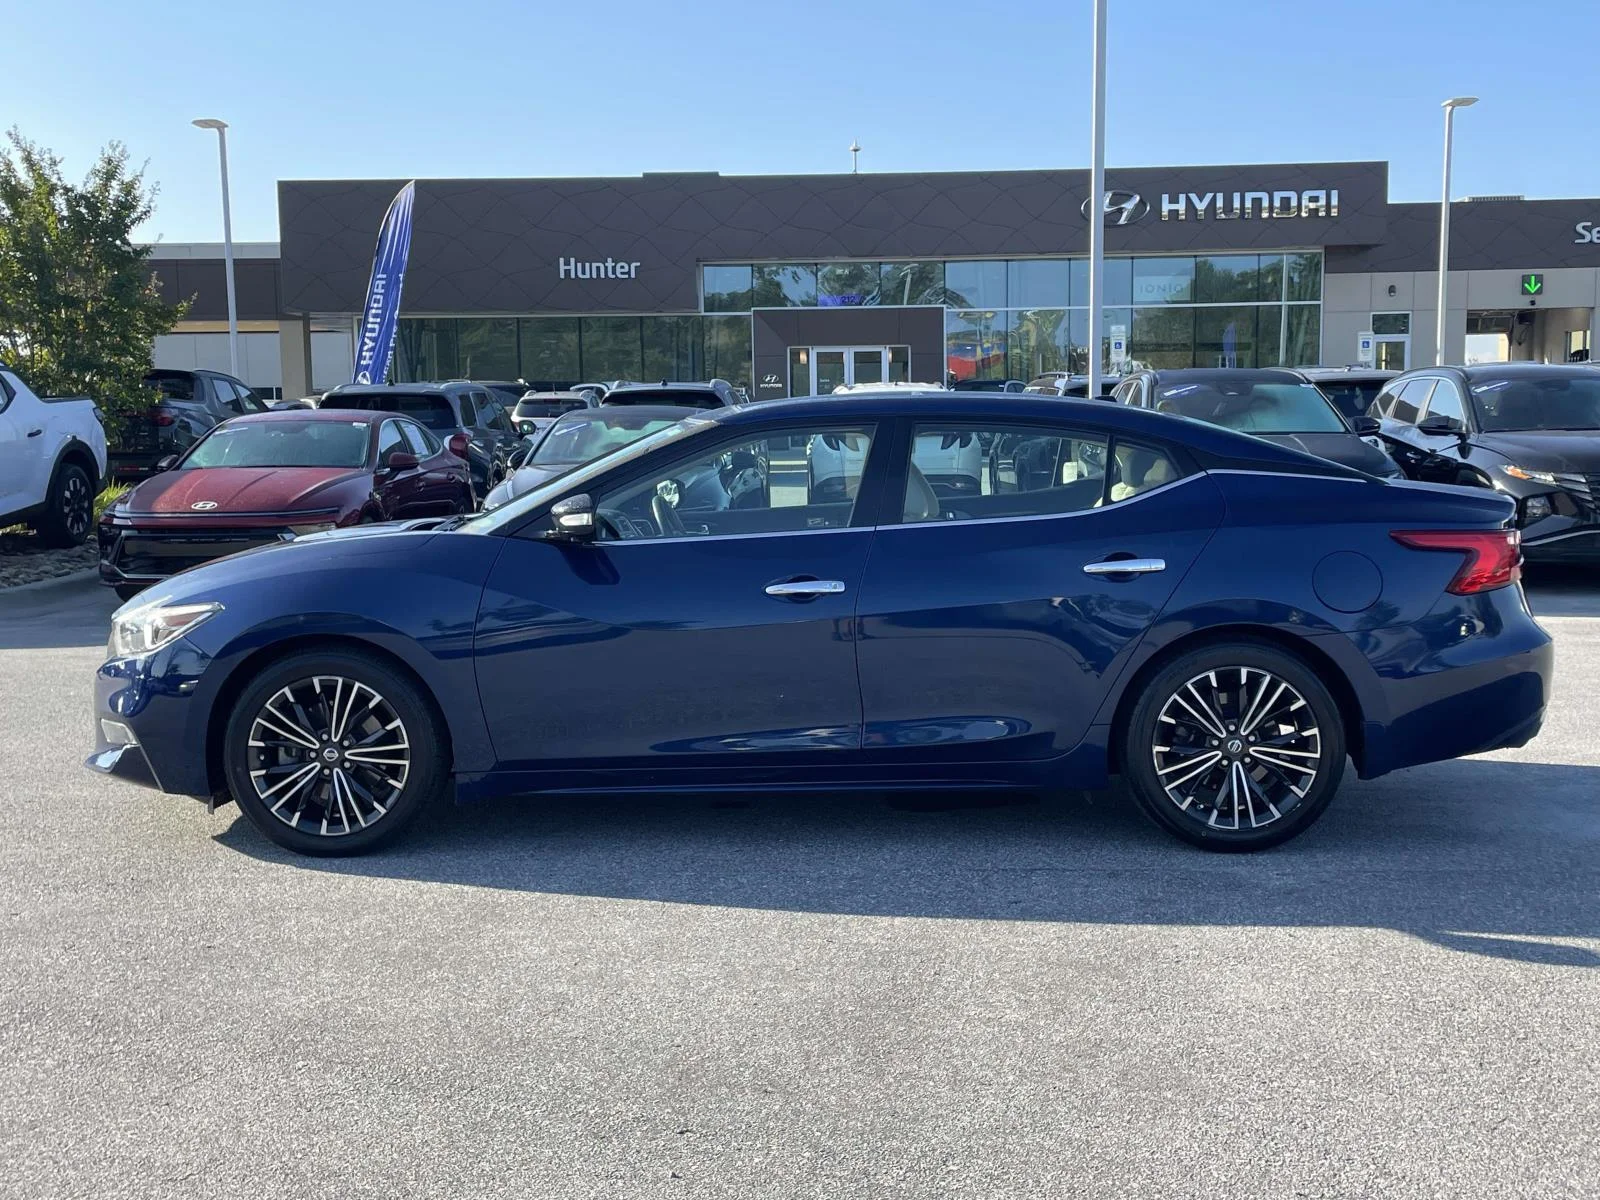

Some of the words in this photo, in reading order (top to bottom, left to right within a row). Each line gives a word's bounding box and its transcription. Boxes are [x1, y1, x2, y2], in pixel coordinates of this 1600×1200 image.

[1161, 189, 1339, 221] HYUNDAI
[559, 257, 641, 279] Hunter
[360, 273, 387, 365] HYUNDAI
